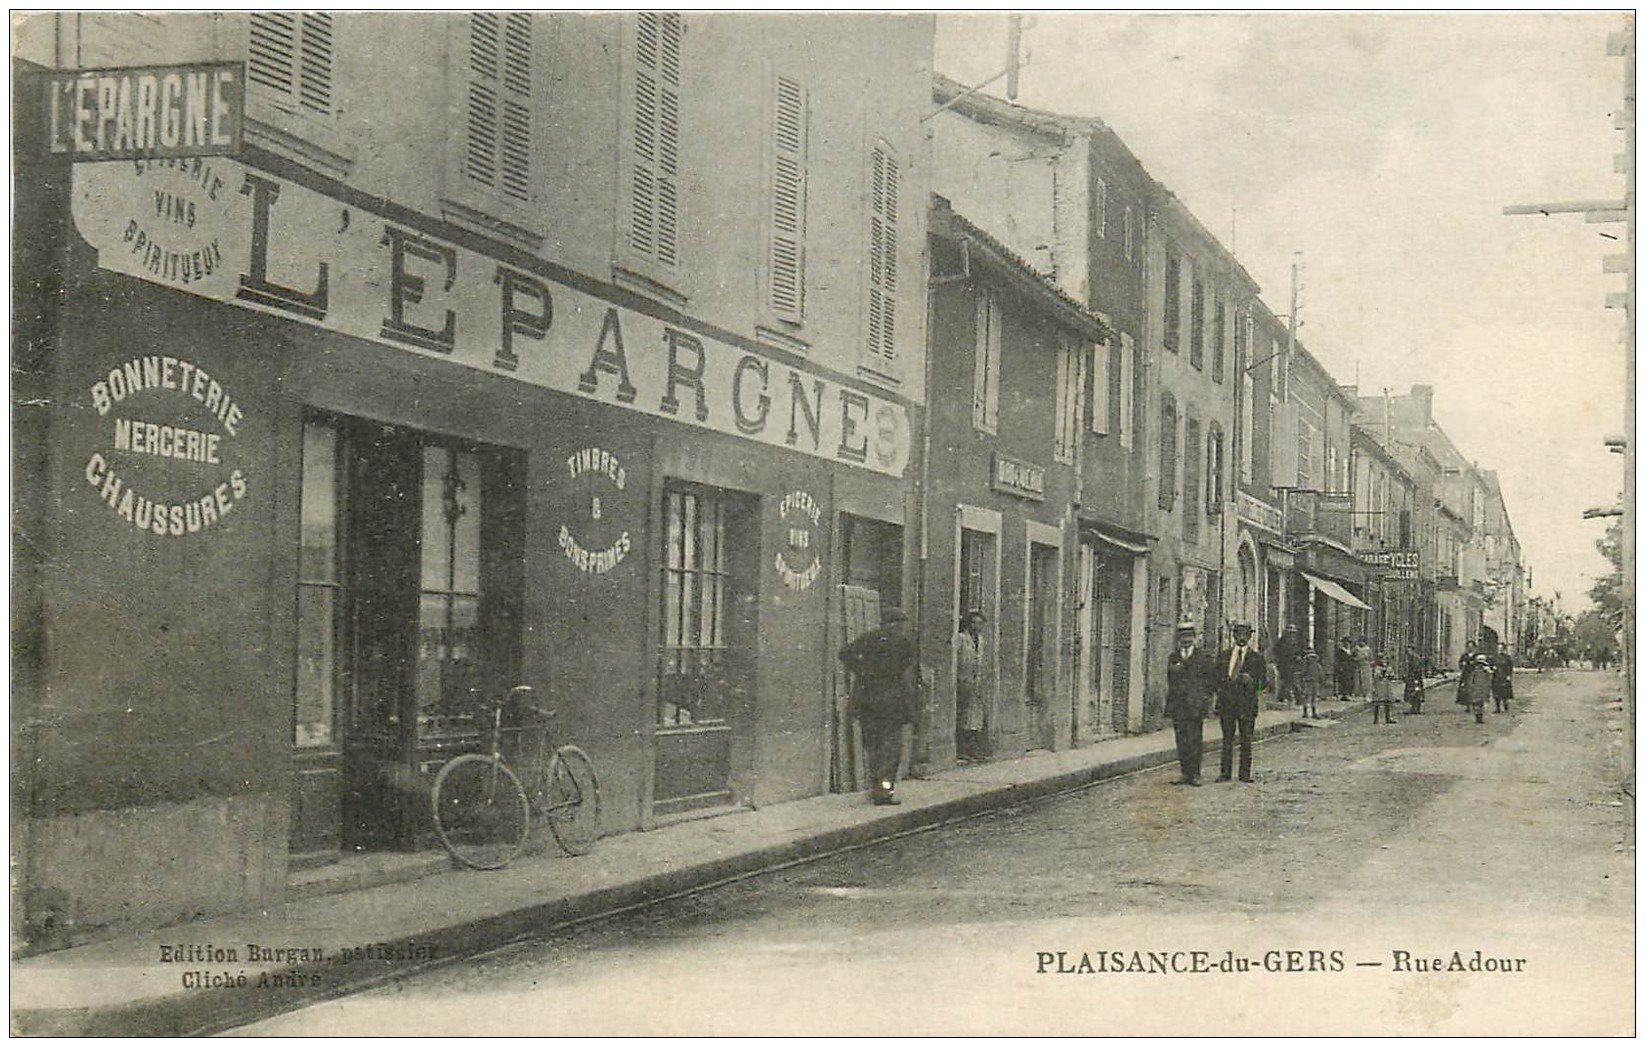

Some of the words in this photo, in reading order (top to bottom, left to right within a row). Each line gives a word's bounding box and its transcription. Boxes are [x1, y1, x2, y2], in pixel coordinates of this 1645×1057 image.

[155, 190, 196, 229] VINS
[123, 219, 223, 285] SPIRITUEUX
[236, 173, 869, 463] L'EPARGNE
[91, 355, 244, 437] BONNETERIE
[114, 418, 221, 464] MERCERIE
[567, 448, 626, 490] TIMBRES
[86, 452, 247, 536] CHAUSSURES
